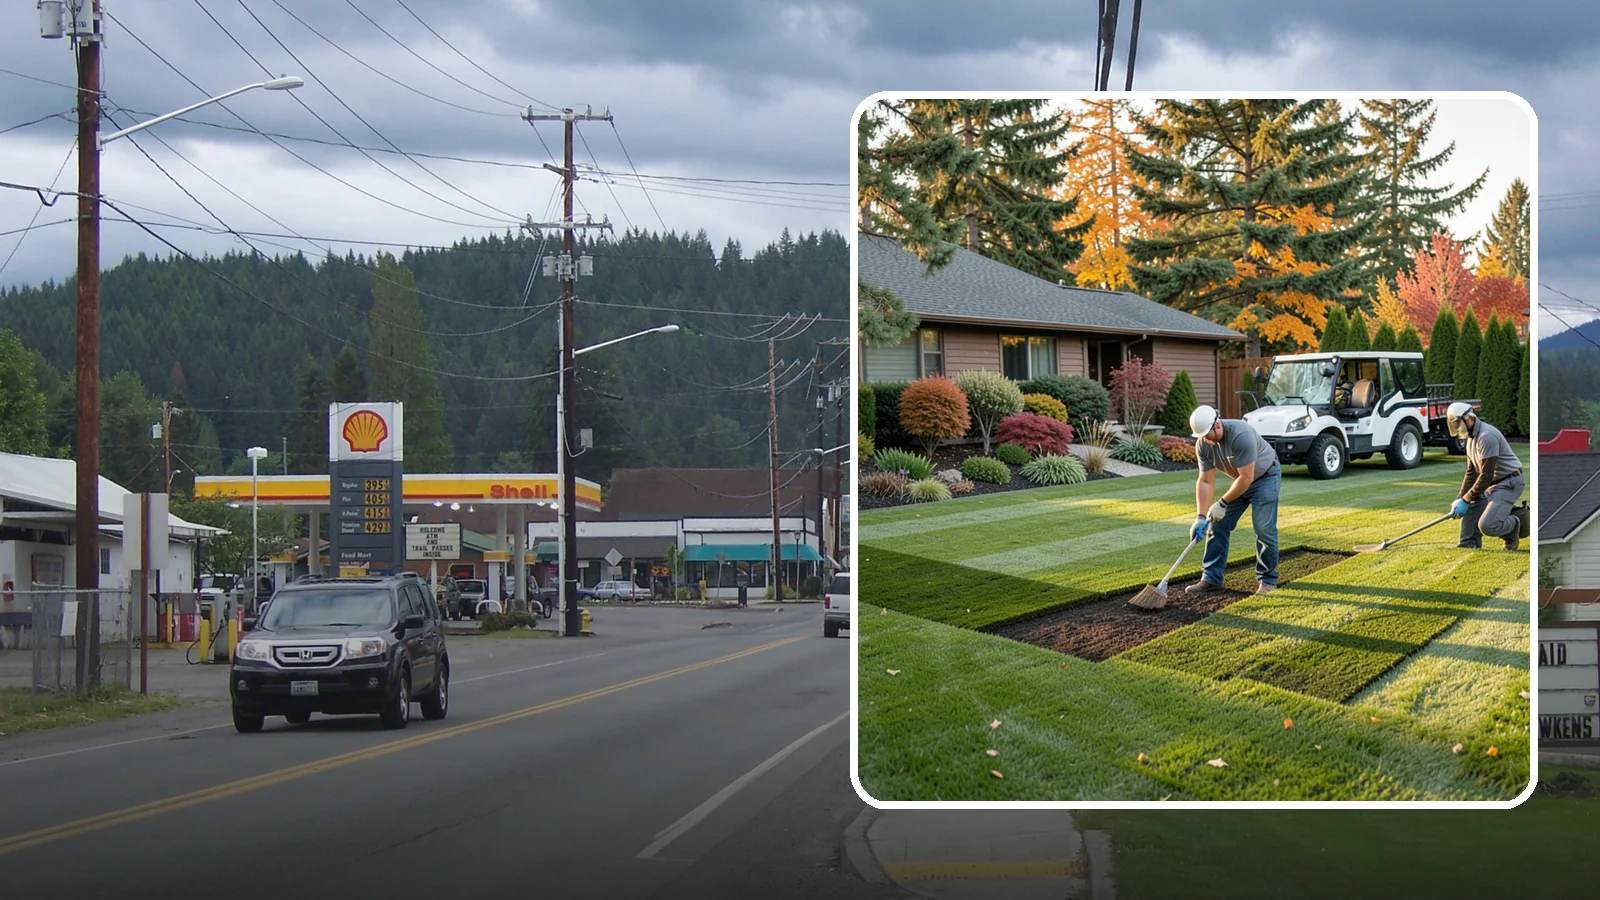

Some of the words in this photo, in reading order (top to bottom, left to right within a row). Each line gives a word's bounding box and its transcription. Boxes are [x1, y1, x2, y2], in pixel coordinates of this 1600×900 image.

[366, 480, 383, 490] 395
[490, 484, 547, 498] Shell
[366, 494, 383, 504] 405
[366, 508, 383, 518] 415
[366, 522, 383, 532] 429
